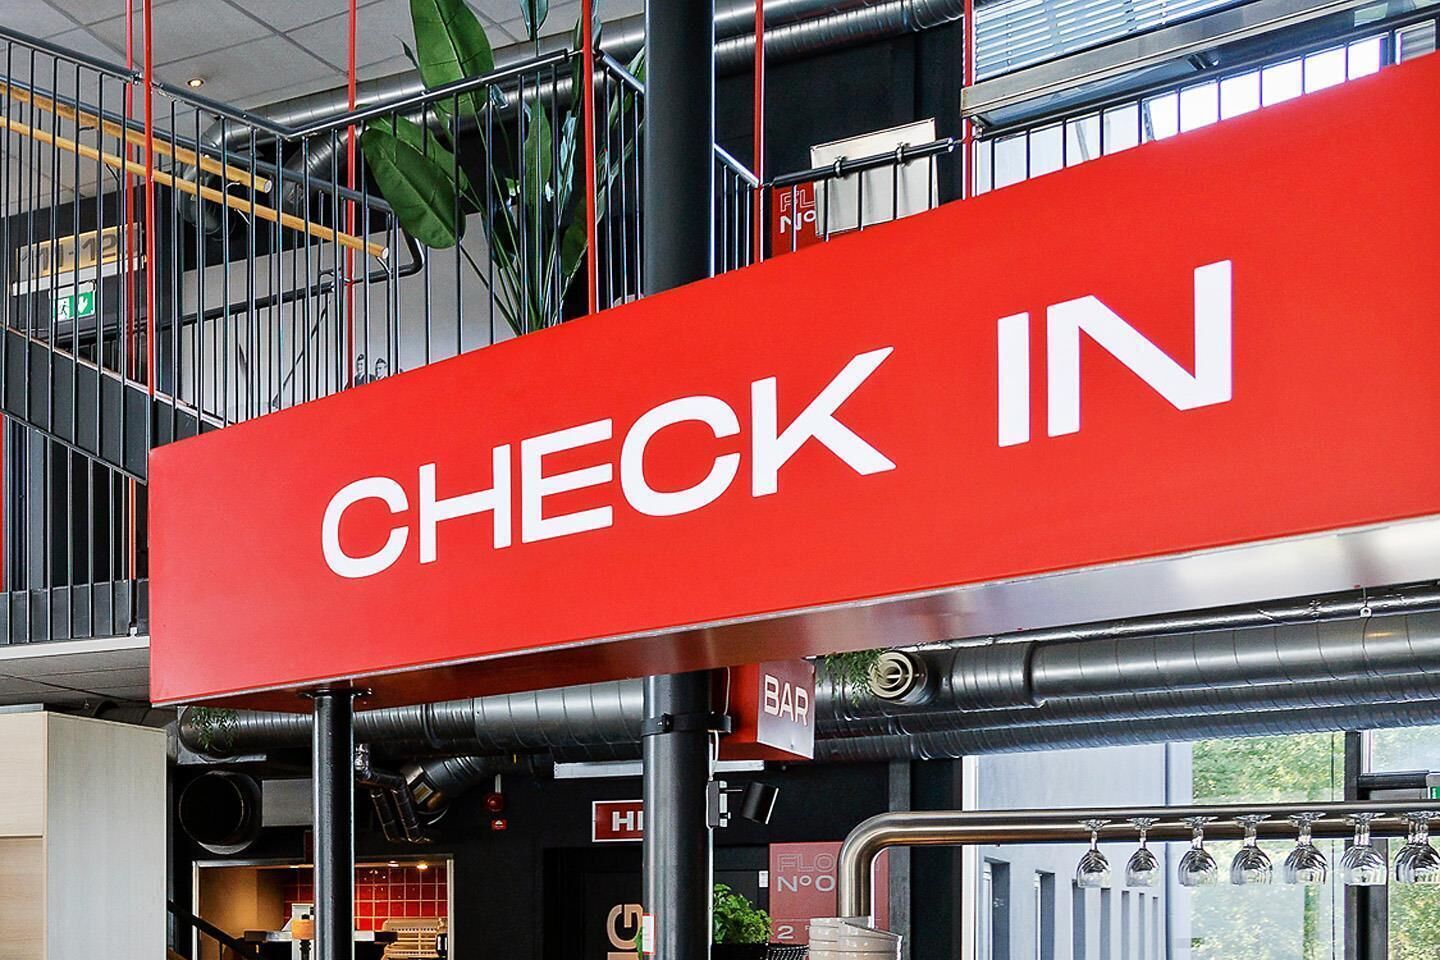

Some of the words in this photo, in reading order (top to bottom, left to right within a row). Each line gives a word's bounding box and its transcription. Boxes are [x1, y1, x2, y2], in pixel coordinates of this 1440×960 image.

[322, 346, 897, 579] CHECK
[997, 259, 1233, 449] IN
[764, 674, 809, 726] BAR
[612, 810, 644, 831] HI
[776, 853, 836, 873] FLO
[776, 925, 795, 940] 2
